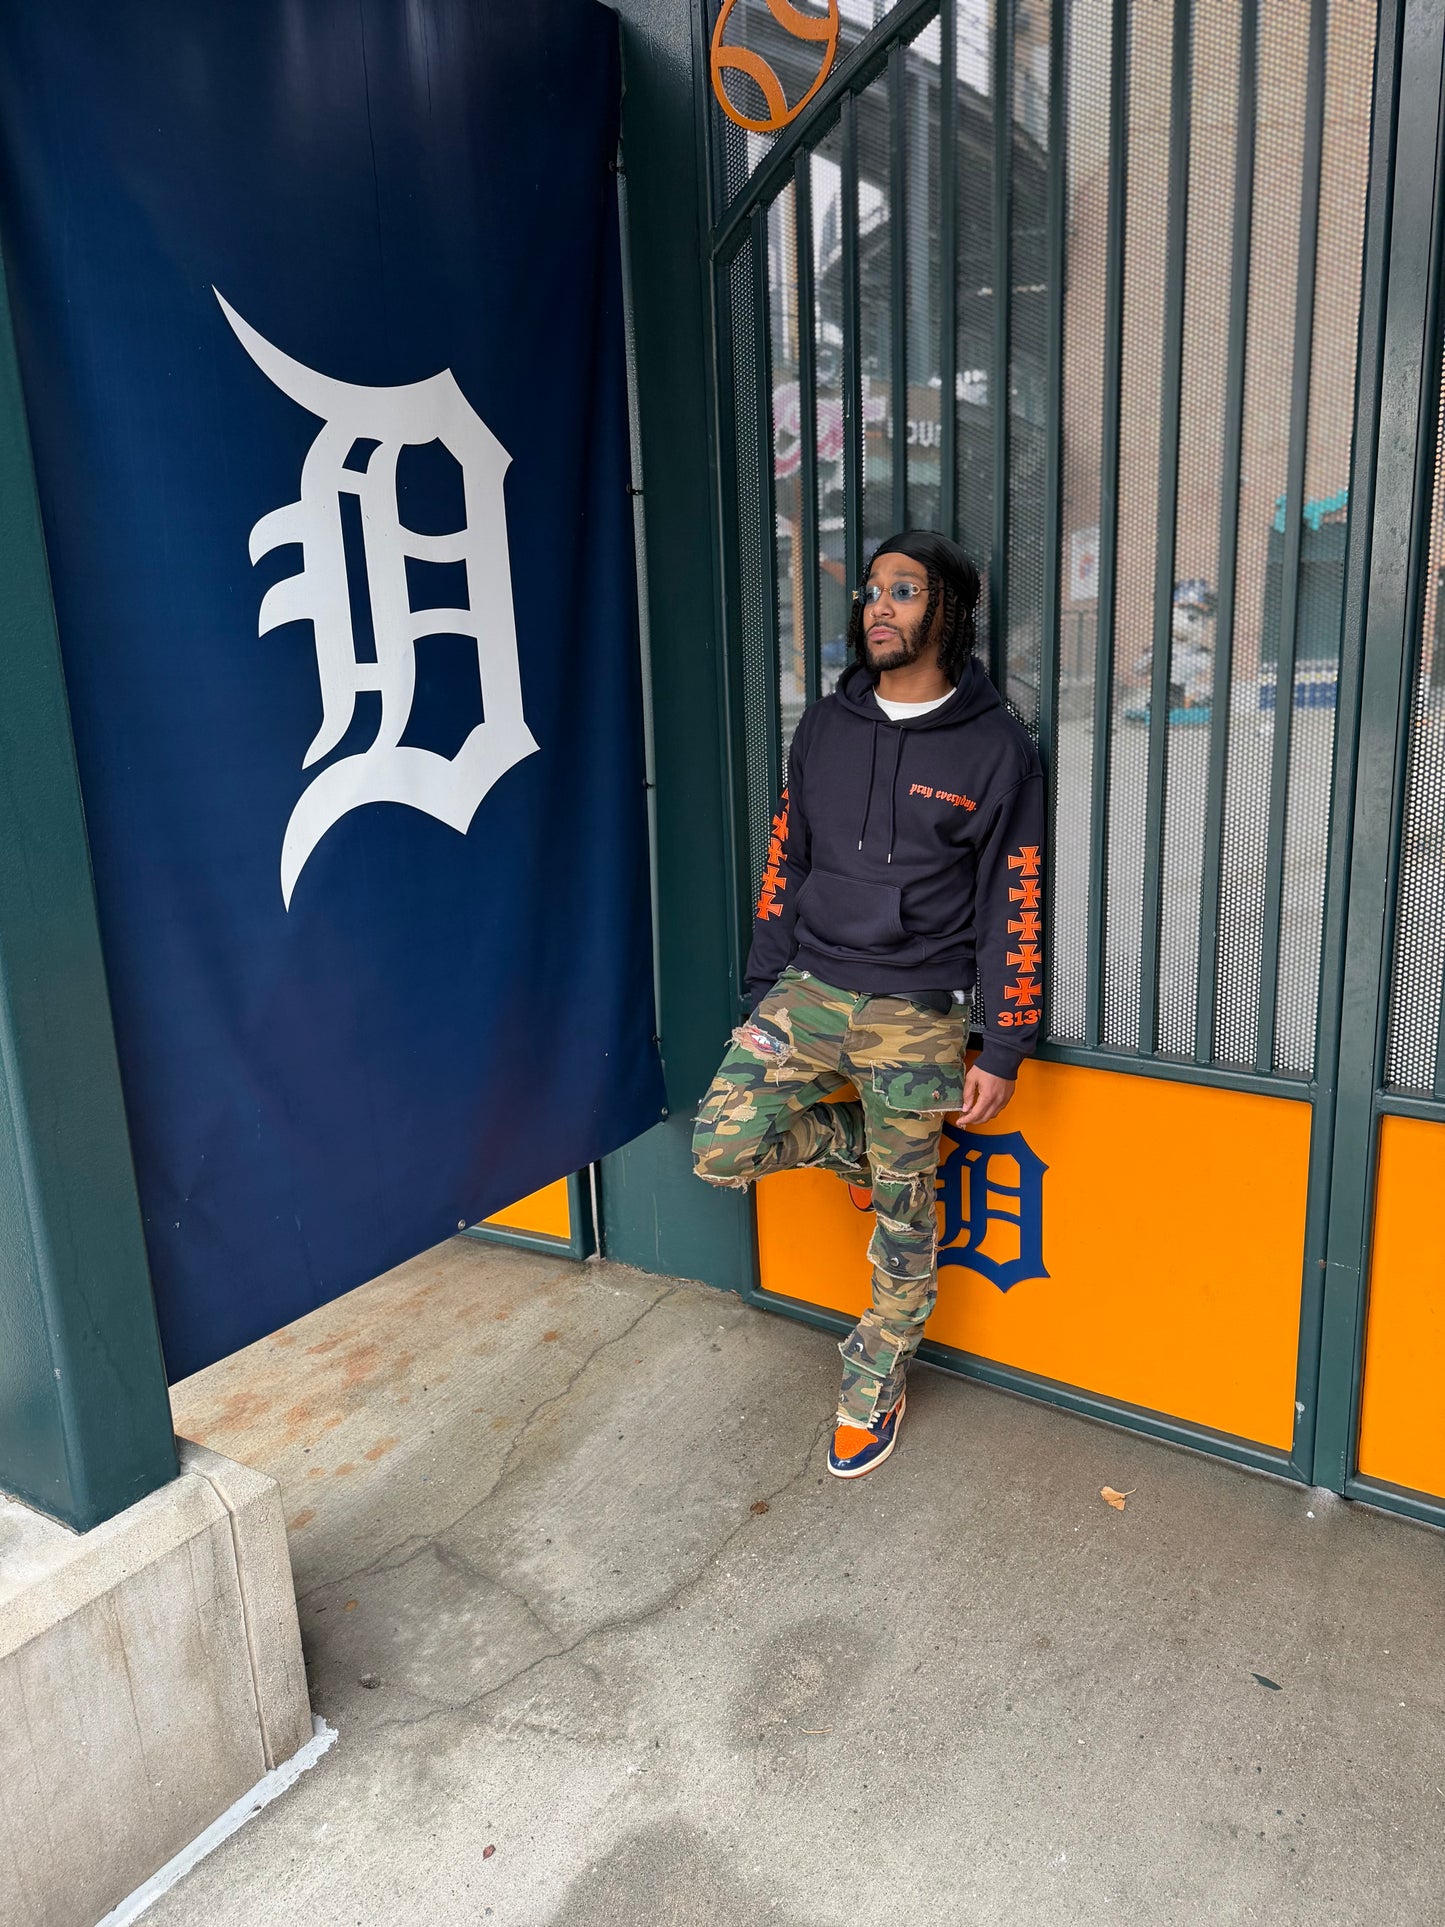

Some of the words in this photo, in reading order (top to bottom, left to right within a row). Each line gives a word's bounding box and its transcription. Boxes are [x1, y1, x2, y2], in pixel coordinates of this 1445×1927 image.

[212, 285, 540, 912] D
[908, 783, 934, 799] pray
[935, 790, 977, 812] everyday.
[936, 1120, 1051, 1294] D
